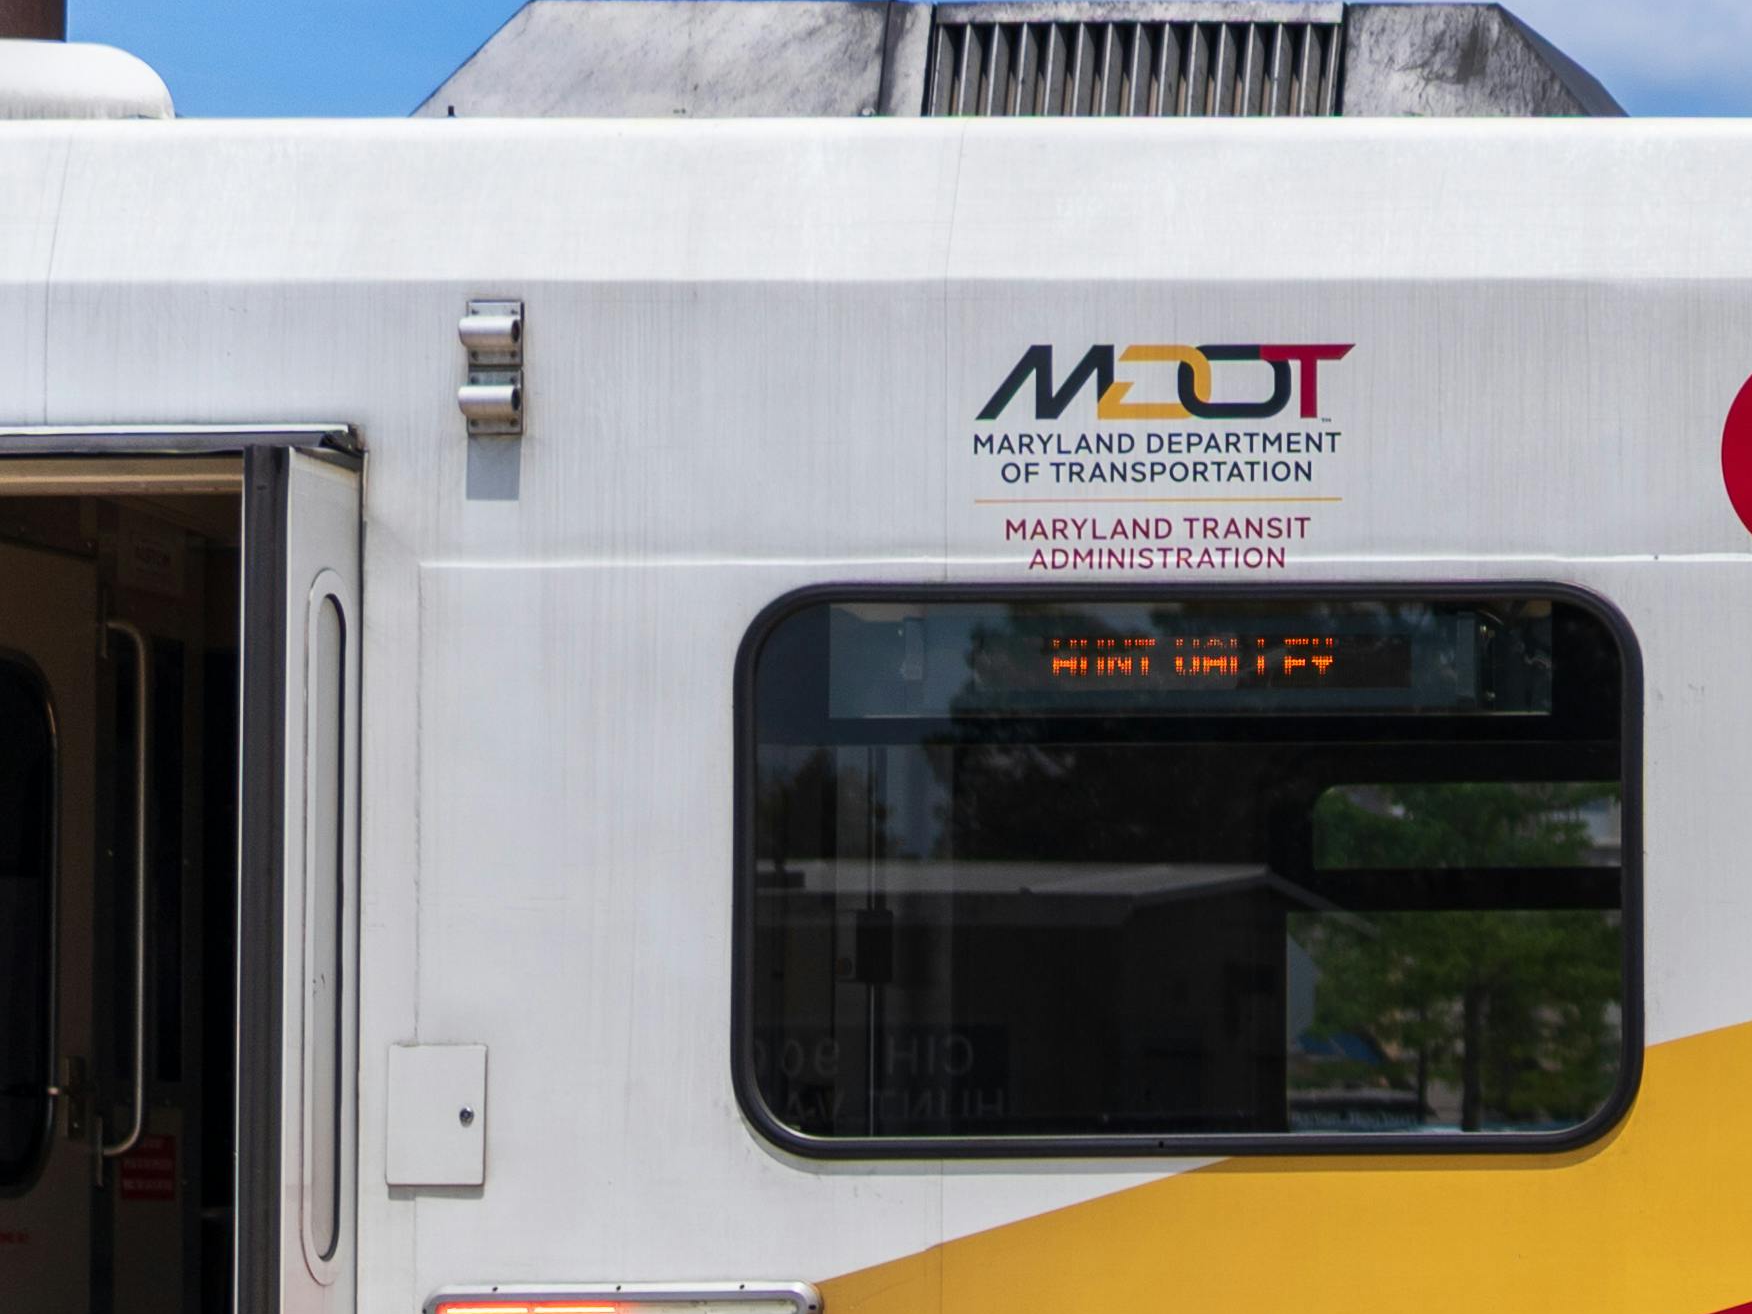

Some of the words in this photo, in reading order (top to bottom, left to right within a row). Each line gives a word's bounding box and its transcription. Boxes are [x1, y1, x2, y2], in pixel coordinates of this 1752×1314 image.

[975, 343, 1356, 420] MDOT
[974, 433, 1135, 455] MARYLAND
[1146, 431, 1342, 454] DEPARTMENT
[1001, 462, 1040, 483] OF
[1050, 460, 1313, 483] TRANSPORTATION
[1005, 518, 1173, 541] MARYLAND
[1183, 517, 1311, 540] TRANSIT
[1028, 546, 1286, 570] ADMINISTRATION
